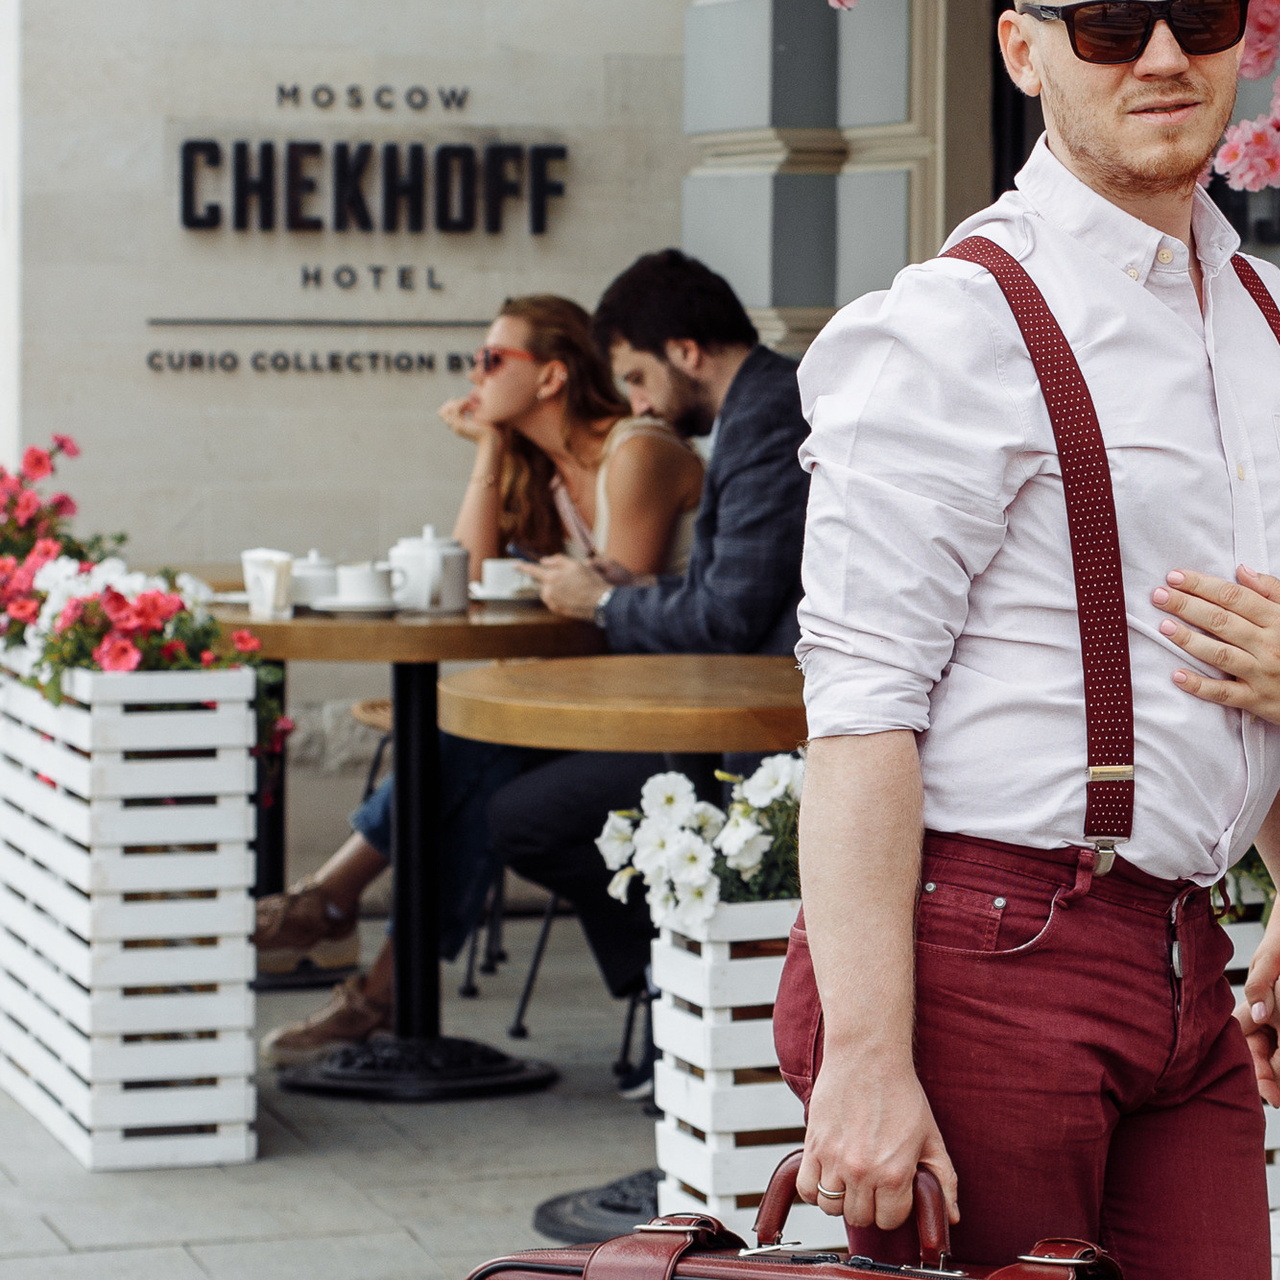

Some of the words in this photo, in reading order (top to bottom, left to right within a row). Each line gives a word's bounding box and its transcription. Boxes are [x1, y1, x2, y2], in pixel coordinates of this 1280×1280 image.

[276, 83, 471, 112] MOSCOW
[180, 138, 568, 236] CHEKHOFF
[300, 265, 444, 292] HOTEL
[250, 350, 436, 374] COLLECTION
